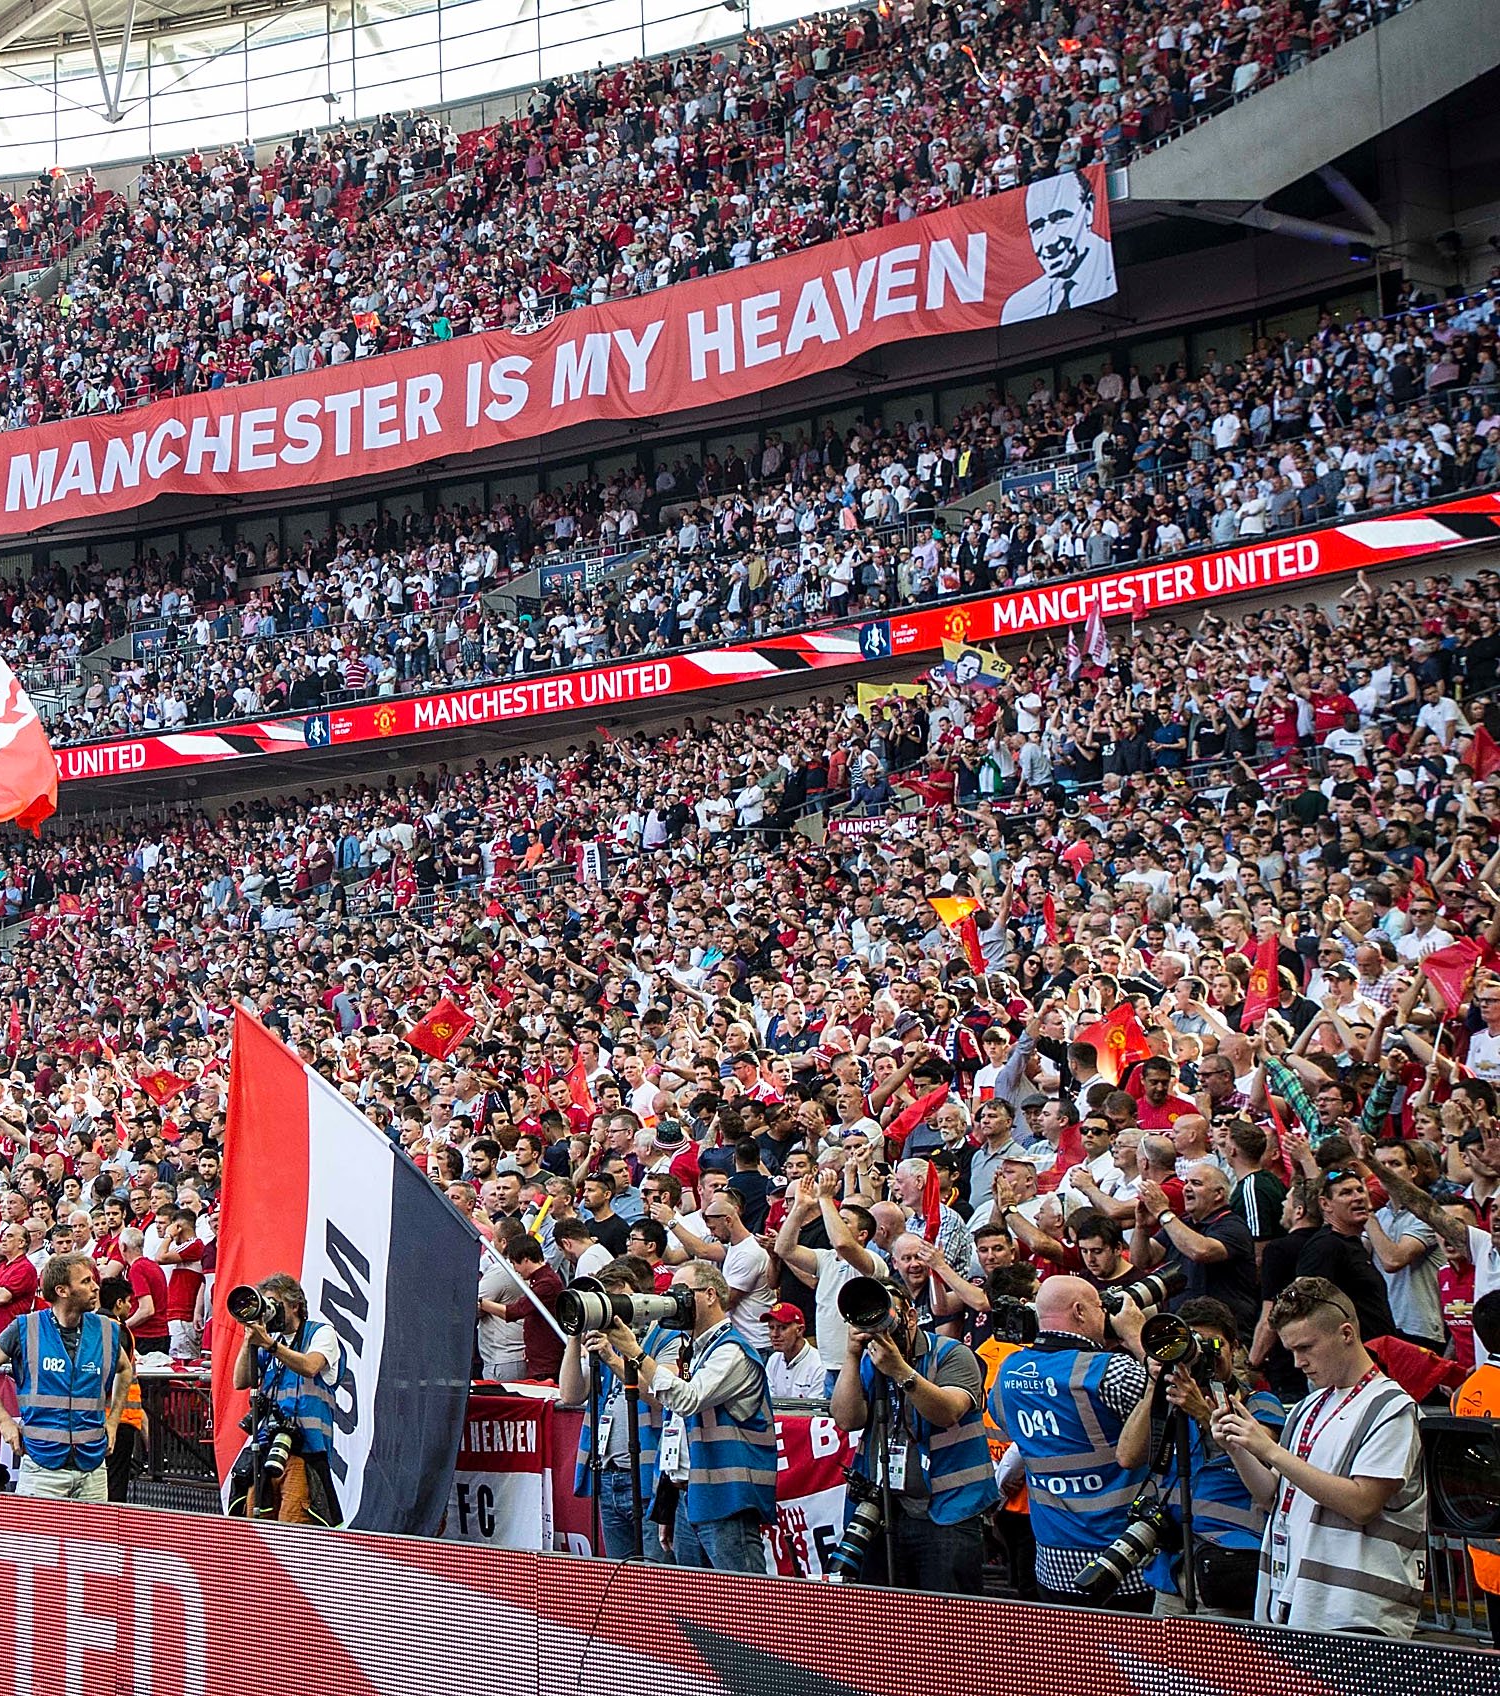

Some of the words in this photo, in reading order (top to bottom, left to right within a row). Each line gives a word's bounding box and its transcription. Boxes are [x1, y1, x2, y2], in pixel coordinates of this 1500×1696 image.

[5, 373, 442, 512] MANCHESTER
[466, 356, 532, 427] IS
[551, 319, 664, 407] MY
[689, 233, 987, 380] HEAVEN
[993, 564, 1196, 632] MANCHESTER
[1203, 539, 1319, 593] UNITED
[991, 659, 1007, 673] 25
[414, 679, 573, 728] MANCHESTER
[581, 663, 671, 702] UNITED
[68, 744, 146, 776] UNITED
[838, 816, 917, 834] MANCHEER
[42, 1357, 66, 1373] 082
[1003, 1378, 1045, 1390] WEMBLEY
[470, 1420, 537, 1453] HEAVEN
[1017, 1409, 1060, 1439] 041
[1030, 1474, 1104, 1495] OTO
[456, 1482, 496, 1538] FC
